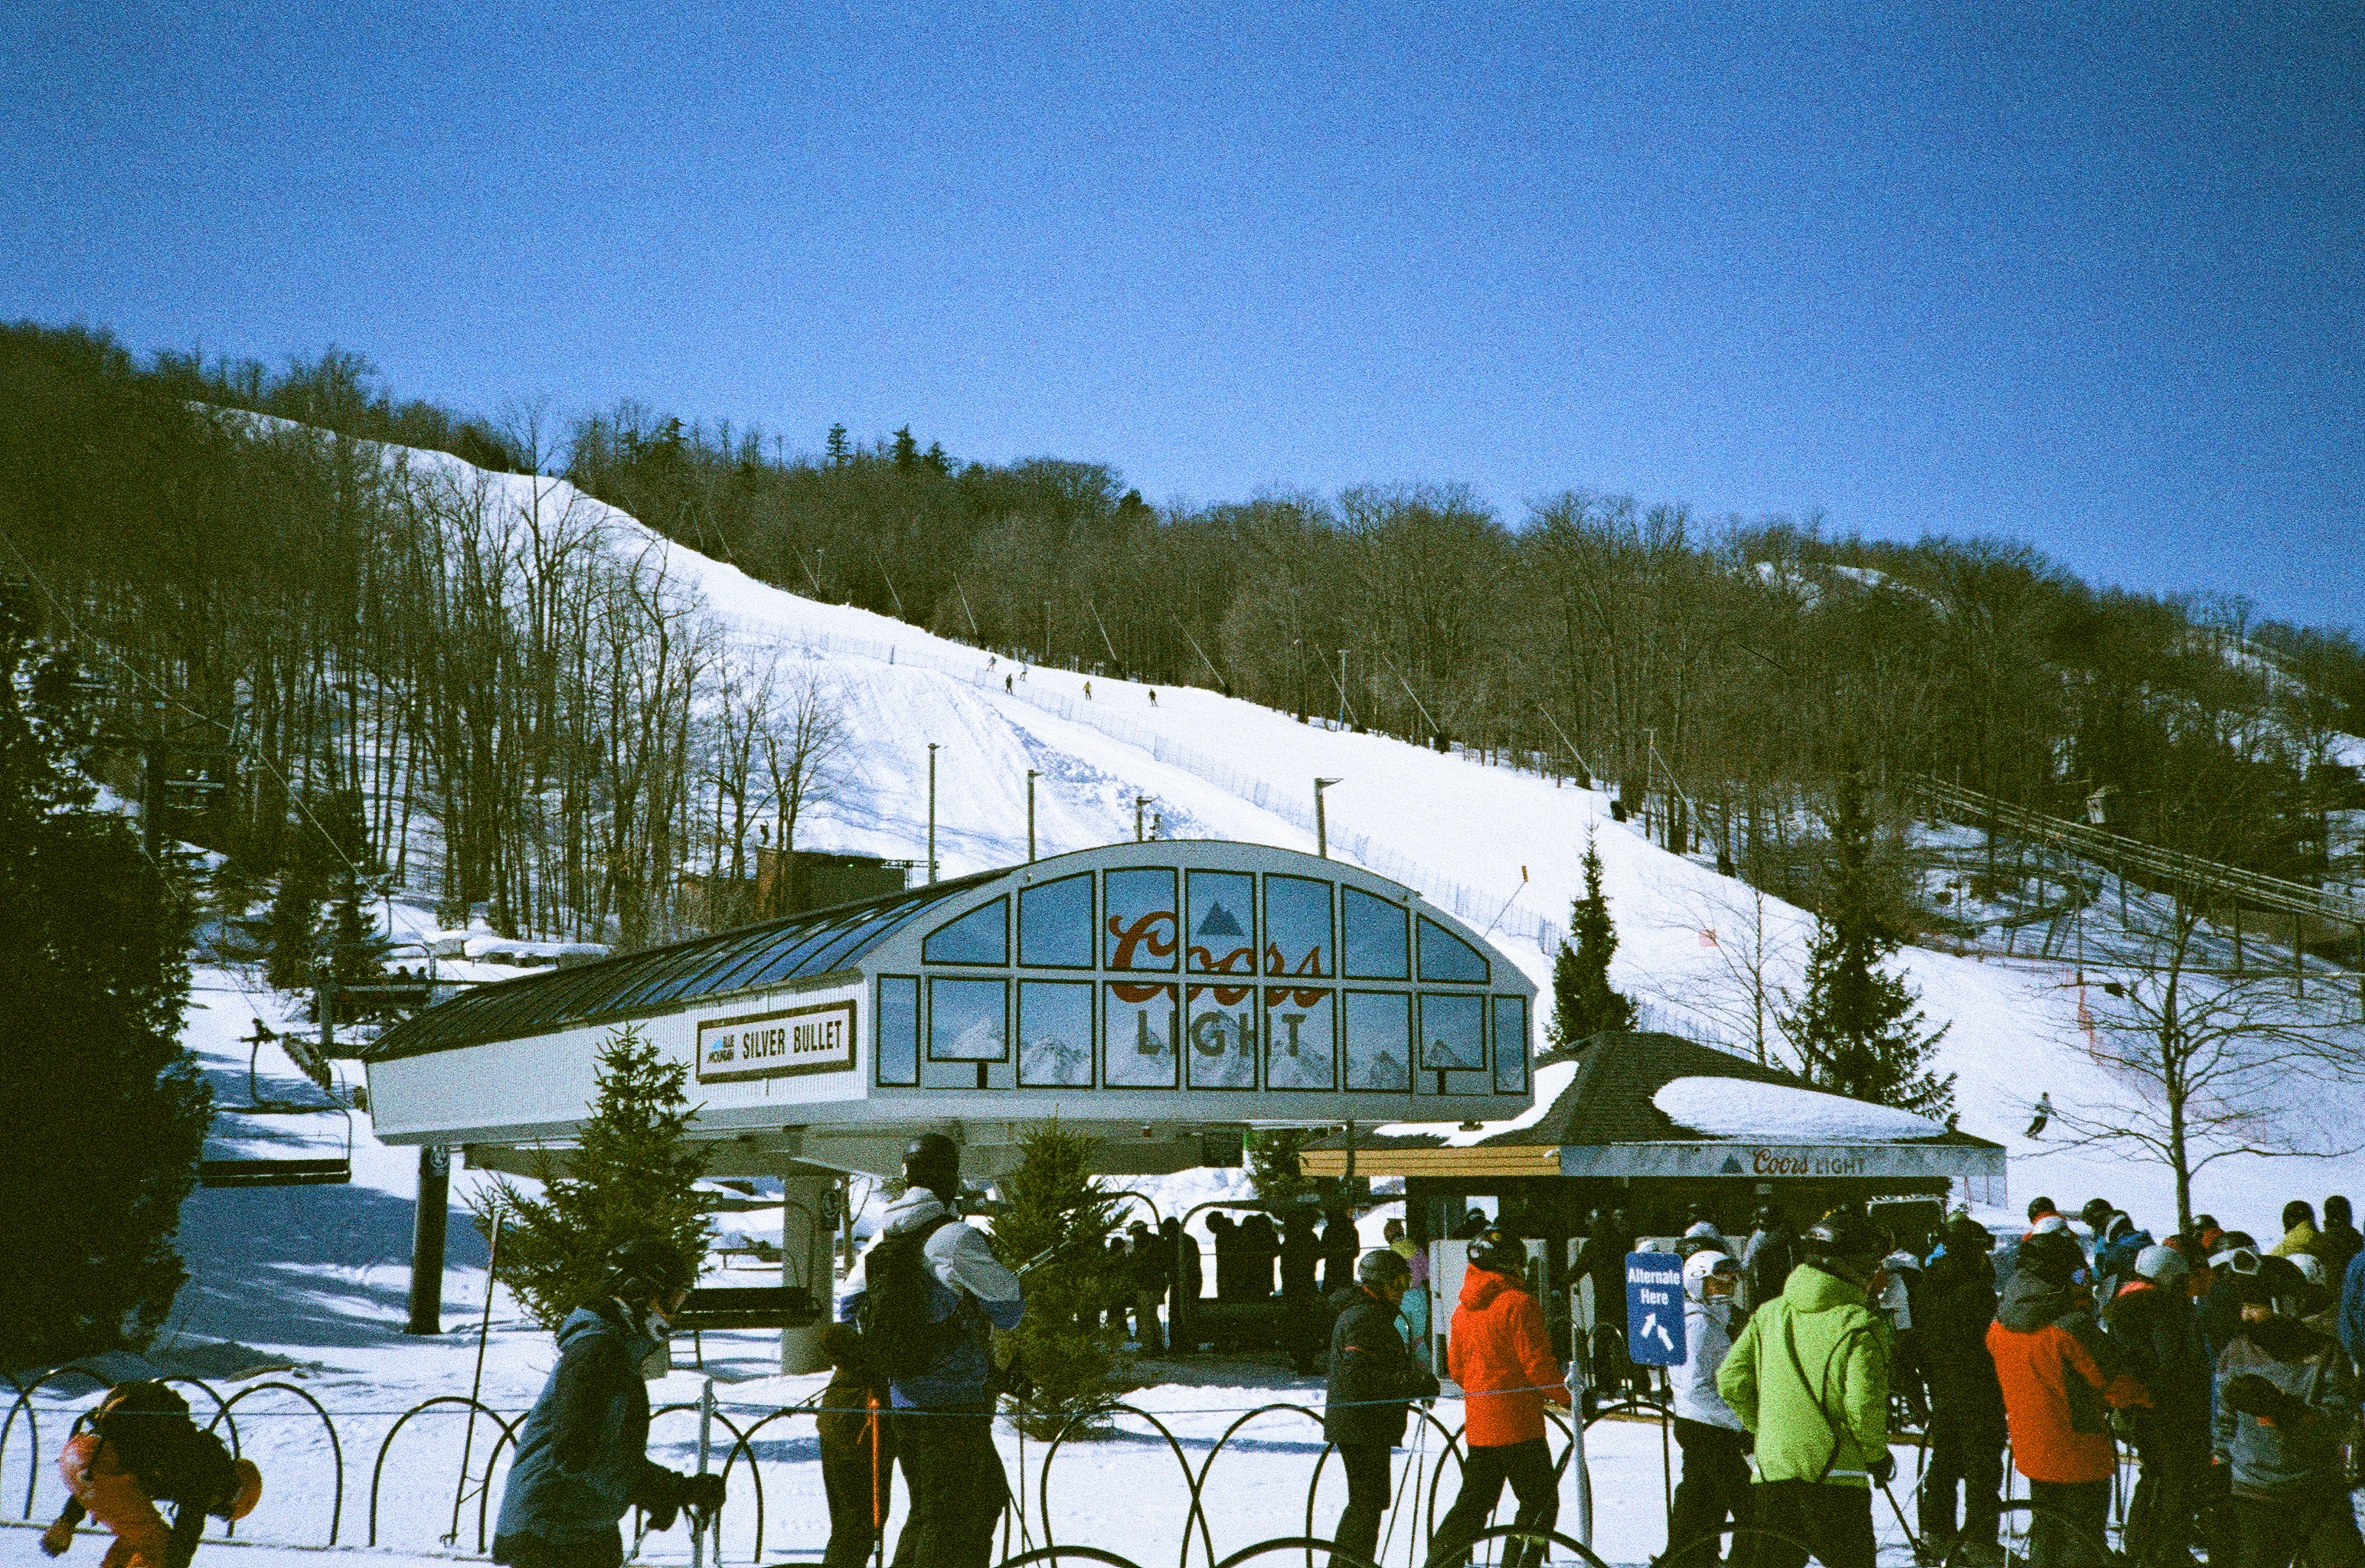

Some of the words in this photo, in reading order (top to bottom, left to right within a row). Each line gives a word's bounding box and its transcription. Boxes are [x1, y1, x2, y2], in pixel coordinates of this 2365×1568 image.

[1109, 910, 1331, 1008] Coors
[742, 1027, 786, 1060] SILVER
[793, 1020, 842, 1054] BULLET
[1137, 1010, 1307, 1057] LIGHT
[1753, 1148, 1809, 1174] Coors
[1815, 1157, 1865, 1174] LIGHT
[1628, 1267, 1681, 1285] Alternate
[1640, 1288, 1668, 1305] Here
